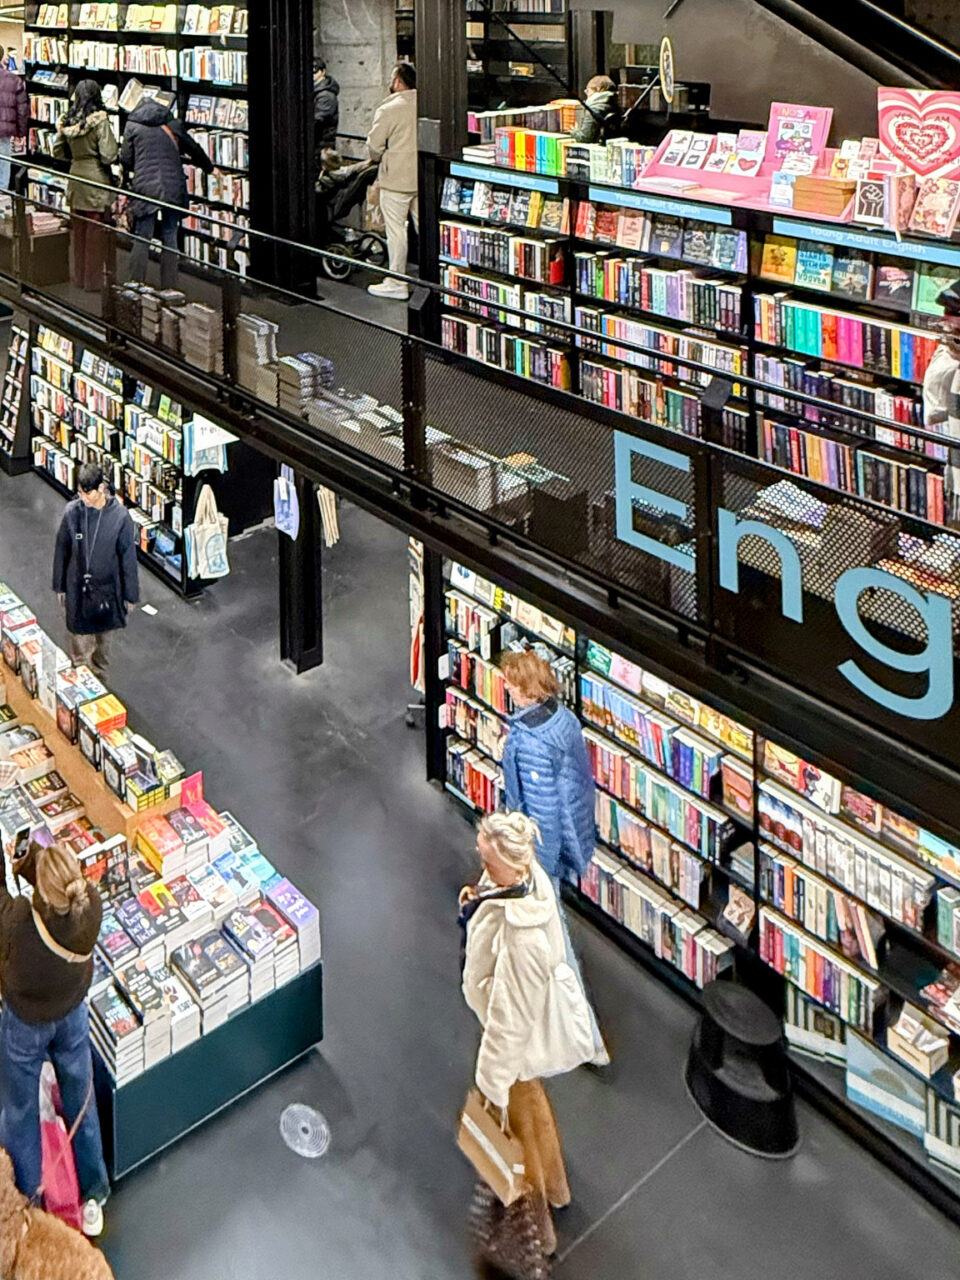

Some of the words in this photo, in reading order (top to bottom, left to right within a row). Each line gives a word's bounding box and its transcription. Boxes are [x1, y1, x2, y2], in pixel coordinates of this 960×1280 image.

[615, 193, 641, 206] Young
[643, 197, 666, 208] Adult
[667, 201, 701, 215] English
[809, 227, 844, 242] Young
[847, 231, 879, 247] Adult
[882, 238, 926, 254] English
[614, 430, 954, 721] Eng
